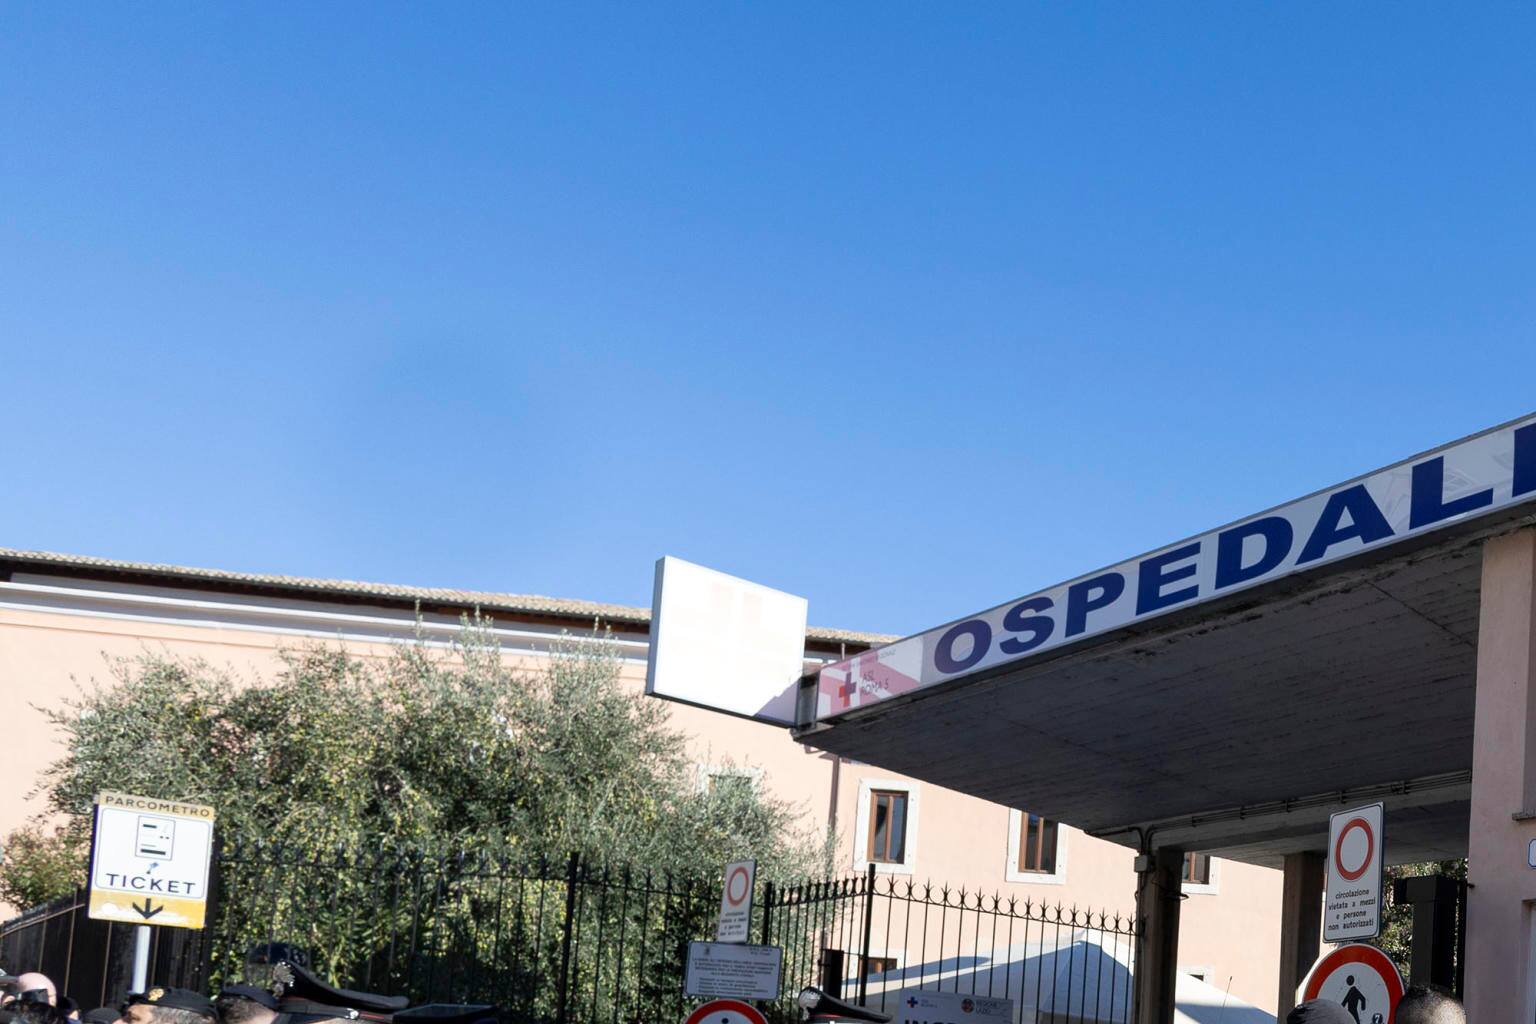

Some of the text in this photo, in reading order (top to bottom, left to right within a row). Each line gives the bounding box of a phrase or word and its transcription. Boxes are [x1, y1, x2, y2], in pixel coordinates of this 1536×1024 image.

[105, 795, 211, 817] PARCOMETRO
[105, 873, 196, 894] TICKET
[1335, 888, 1370, 899] circolazione
[1328, 902, 1348, 911] vietata
[1360, 897, 1376, 906] mezzi
[1343, 910, 1367, 920] persone
[1328, 918, 1374, 931] non autorizzati
